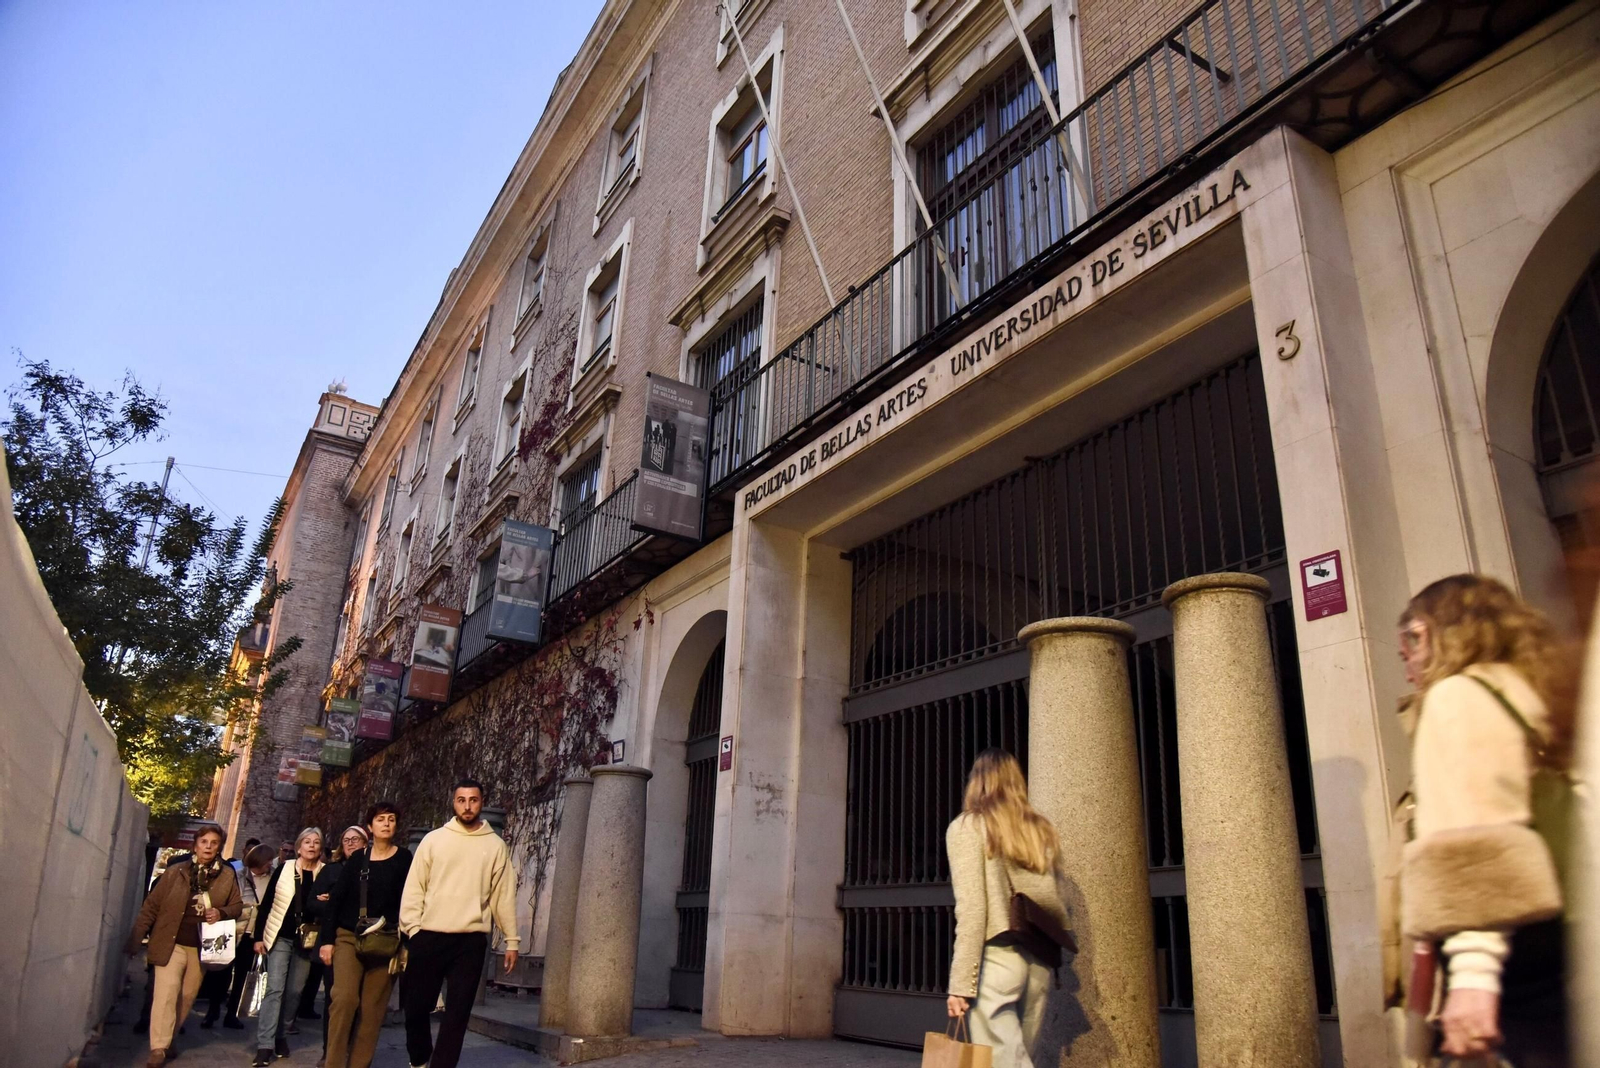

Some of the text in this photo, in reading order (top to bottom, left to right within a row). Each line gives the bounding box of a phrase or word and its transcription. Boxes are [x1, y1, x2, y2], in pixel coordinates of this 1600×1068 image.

[744, 169, 1252, 511] FACULTAD DE BELLAS ARTES UNIVERSIDAD DE SEVILLA
[1275, 319, 1301, 361] 3
